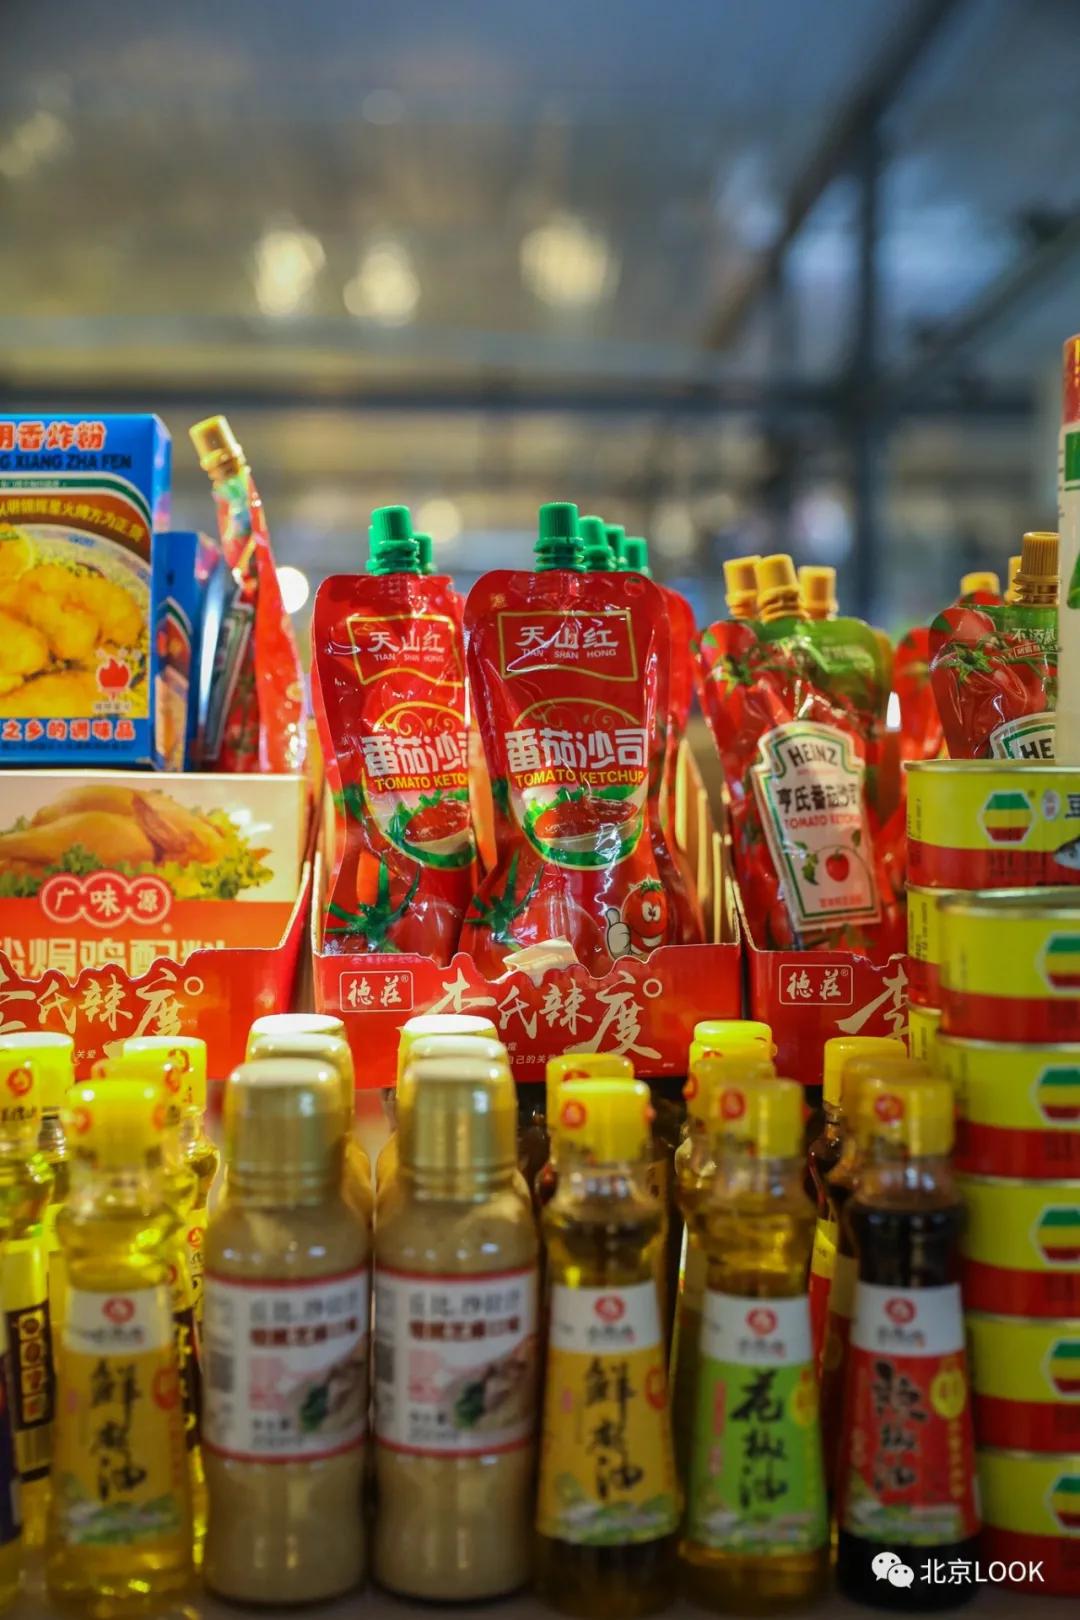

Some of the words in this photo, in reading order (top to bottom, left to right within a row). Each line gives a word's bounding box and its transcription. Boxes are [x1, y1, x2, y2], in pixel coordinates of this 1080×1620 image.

[102, 453, 132, 469] FEN
[367, 626, 445, 652] 天山红
[515, 625, 618, 649] 天山红
[374, 653, 396, 661] TIAN
[554, 651, 579, 659] SHAN
[586, 648, 616, 658] HONG
[506, 728, 648, 771] 番茄沙司
[787, 742, 839, 767] HEINZ
[375, 775, 431, 792] TOMATO
[516, 769, 575, 788] TOMATO
[578, 770, 645, 787] KETCHUP
[55, 883, 159, 918] 广味源
